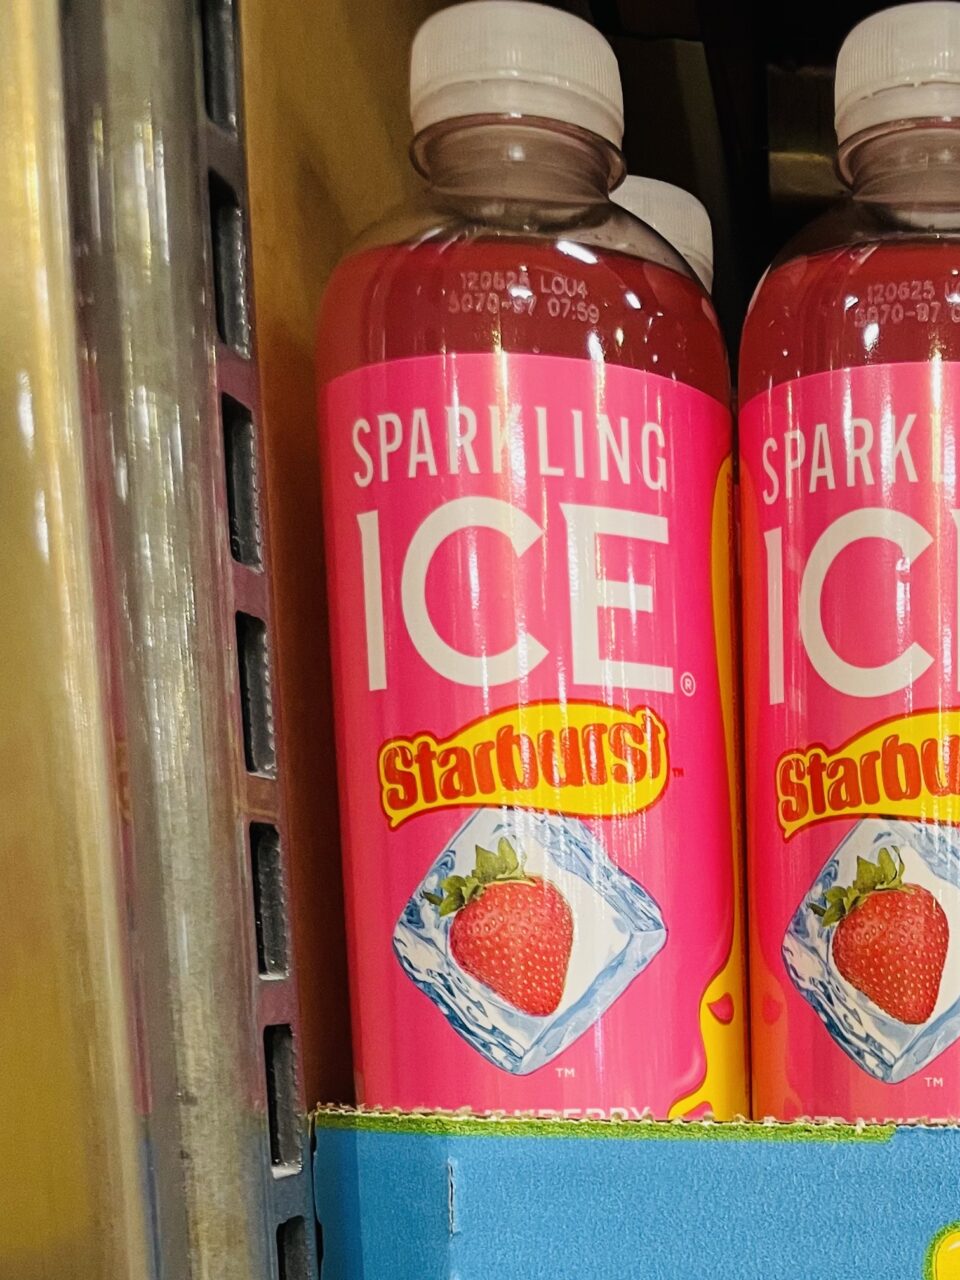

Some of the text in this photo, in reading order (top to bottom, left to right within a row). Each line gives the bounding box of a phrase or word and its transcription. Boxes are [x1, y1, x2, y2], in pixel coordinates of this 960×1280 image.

[547, 298, 600, 324] 07:59
[351, 407, 667, 492] SPARKLING
[355, 494, 676, 693] ICE
[382, 710, 668, 806] Starburst
